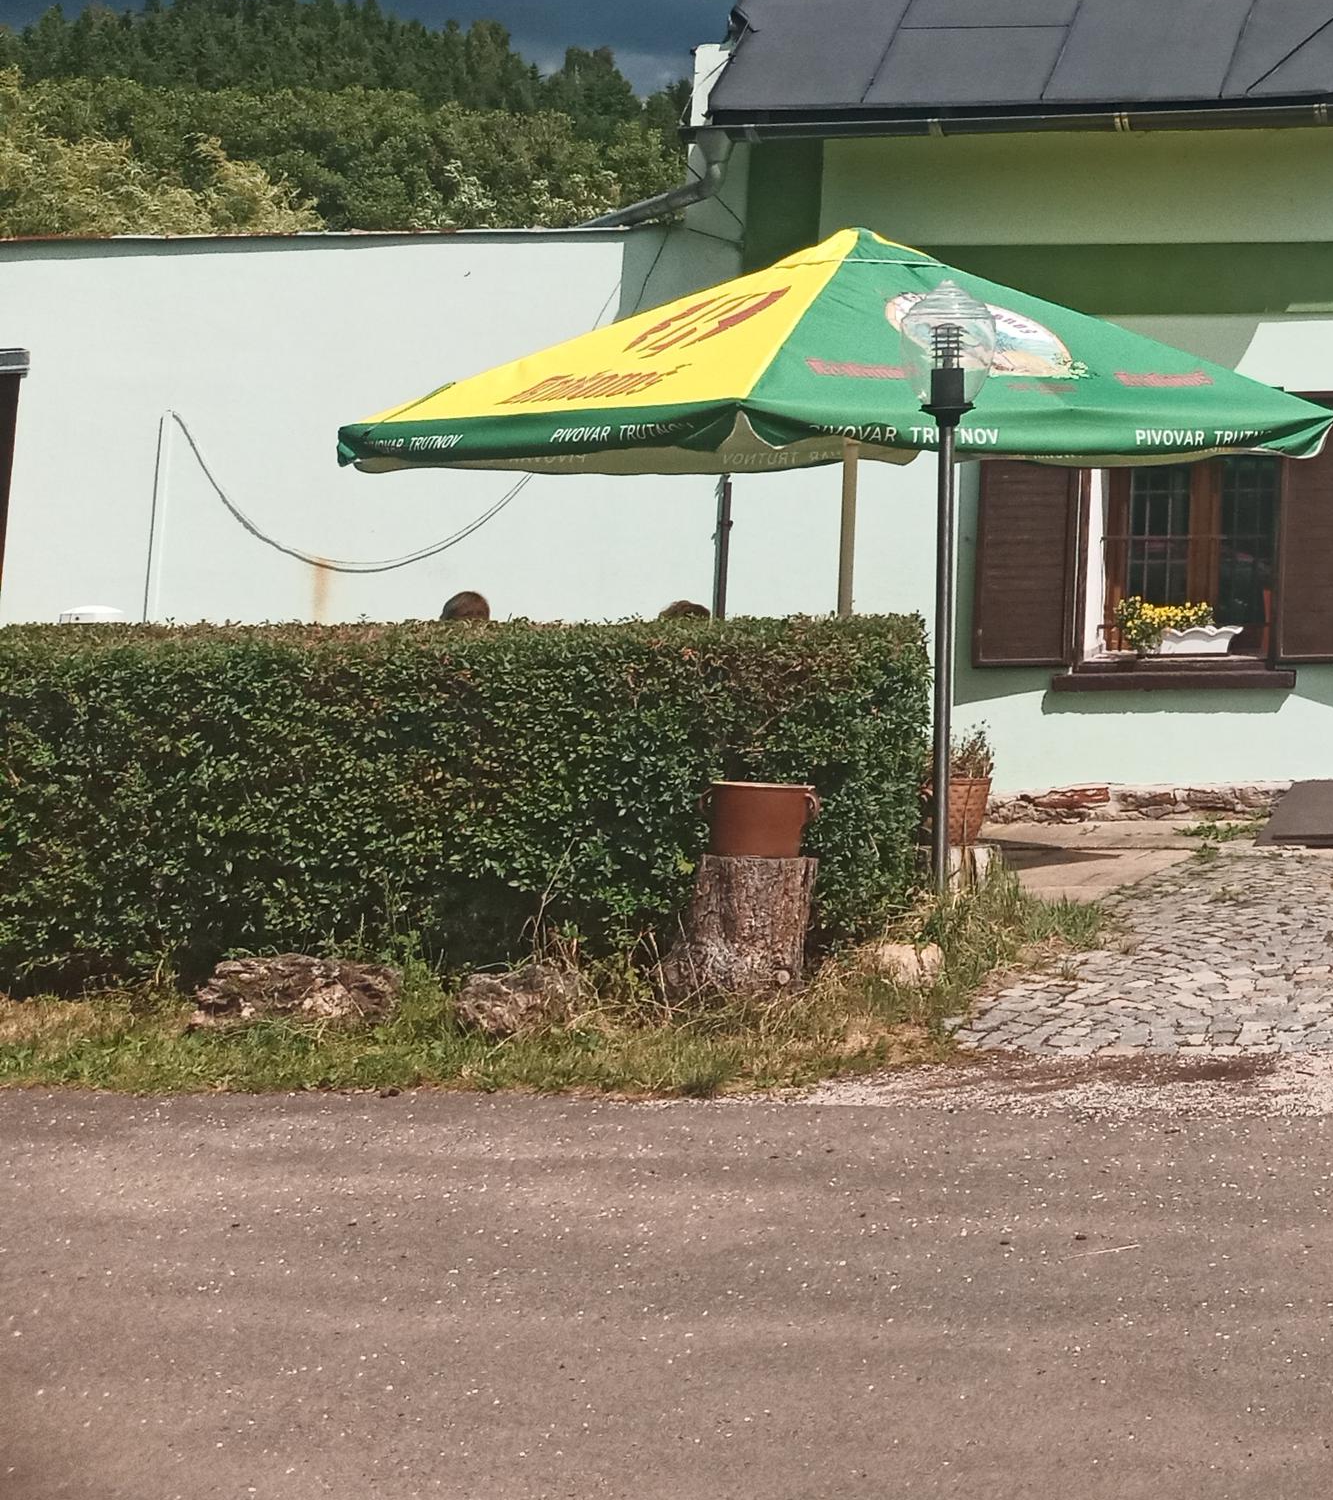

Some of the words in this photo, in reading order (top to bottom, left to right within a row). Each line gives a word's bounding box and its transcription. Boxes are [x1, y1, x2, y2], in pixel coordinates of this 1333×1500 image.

[408, 435, 463, 451] TRUTNOV
[550, 426, 611, 443] PIVOVAR
[910, 427, 998, 445] TRNOV
[1135, 429, 1204, 446] PIVOVAR
